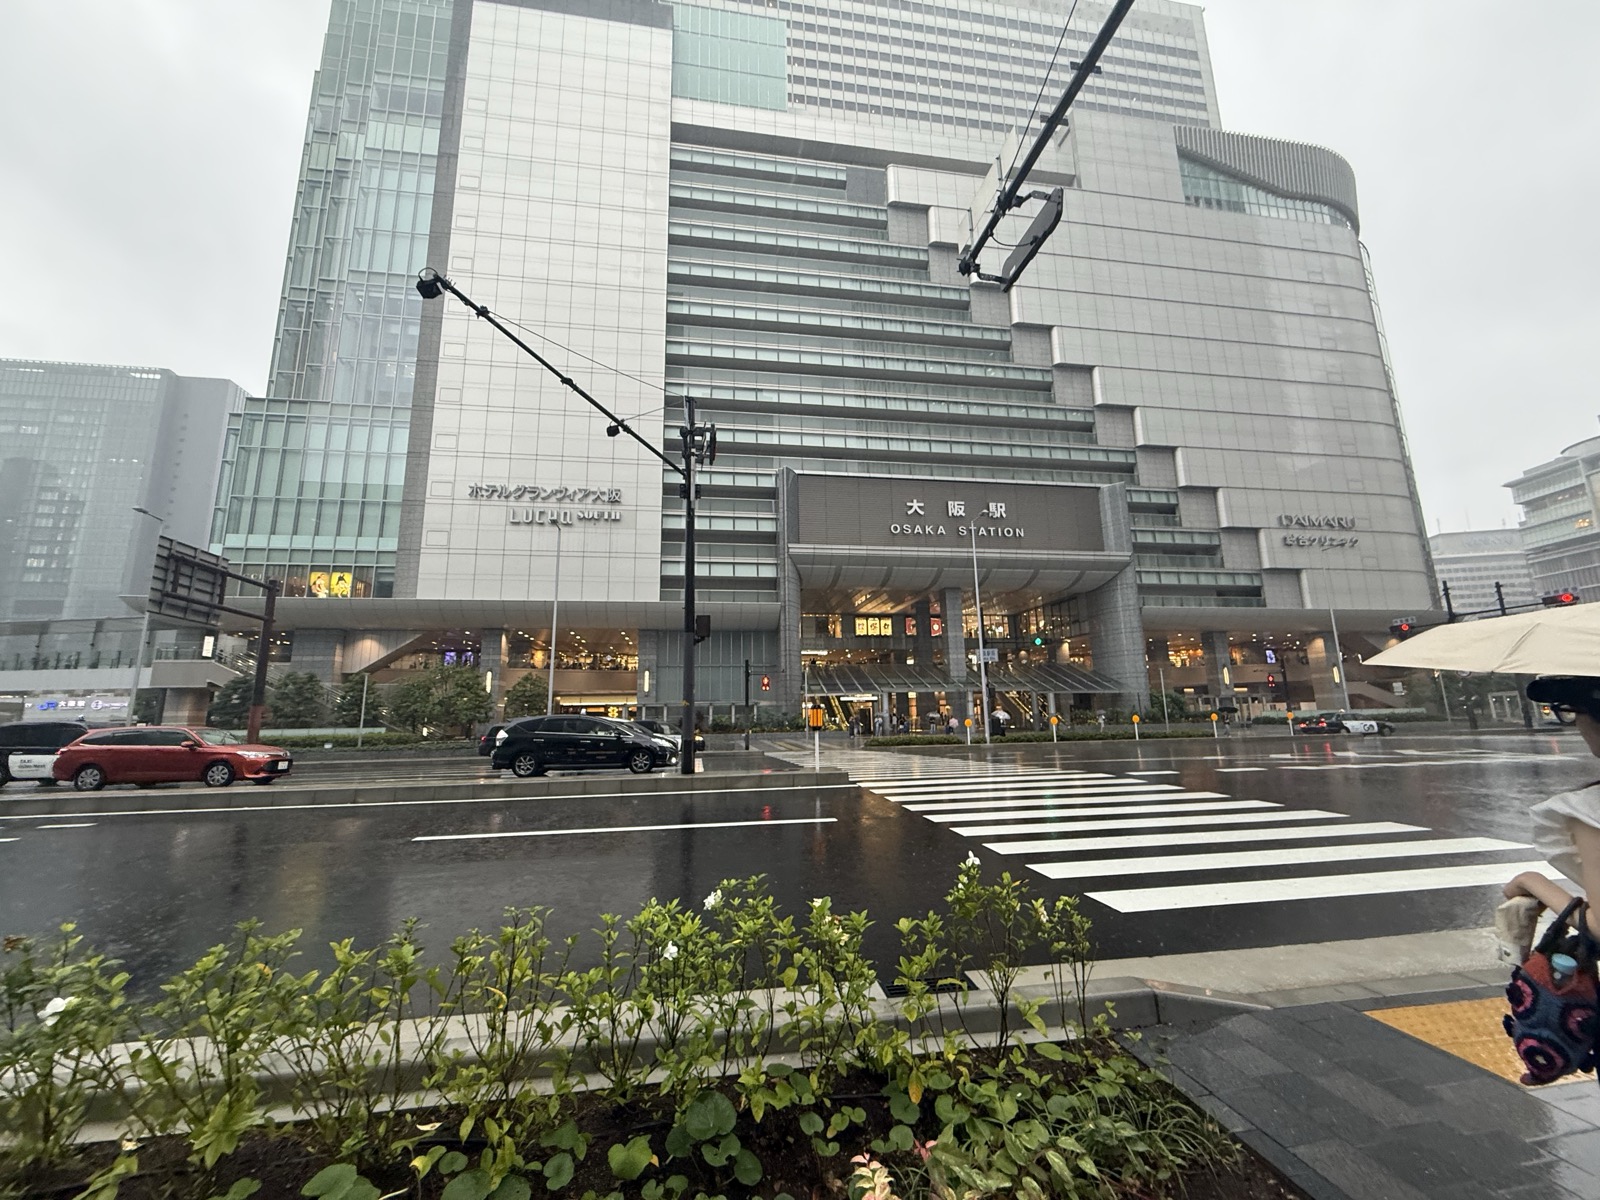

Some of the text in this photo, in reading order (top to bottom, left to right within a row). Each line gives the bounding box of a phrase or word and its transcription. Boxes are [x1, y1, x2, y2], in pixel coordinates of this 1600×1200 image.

[468, 483, 622, 503] ホテルグランヴィア大阪
[906, 499, 1007, 518] 大阪駅
[890, 523, 1025, 537] OSAKA STATION
[1278, 514, 1355, 529] DAIMARU
